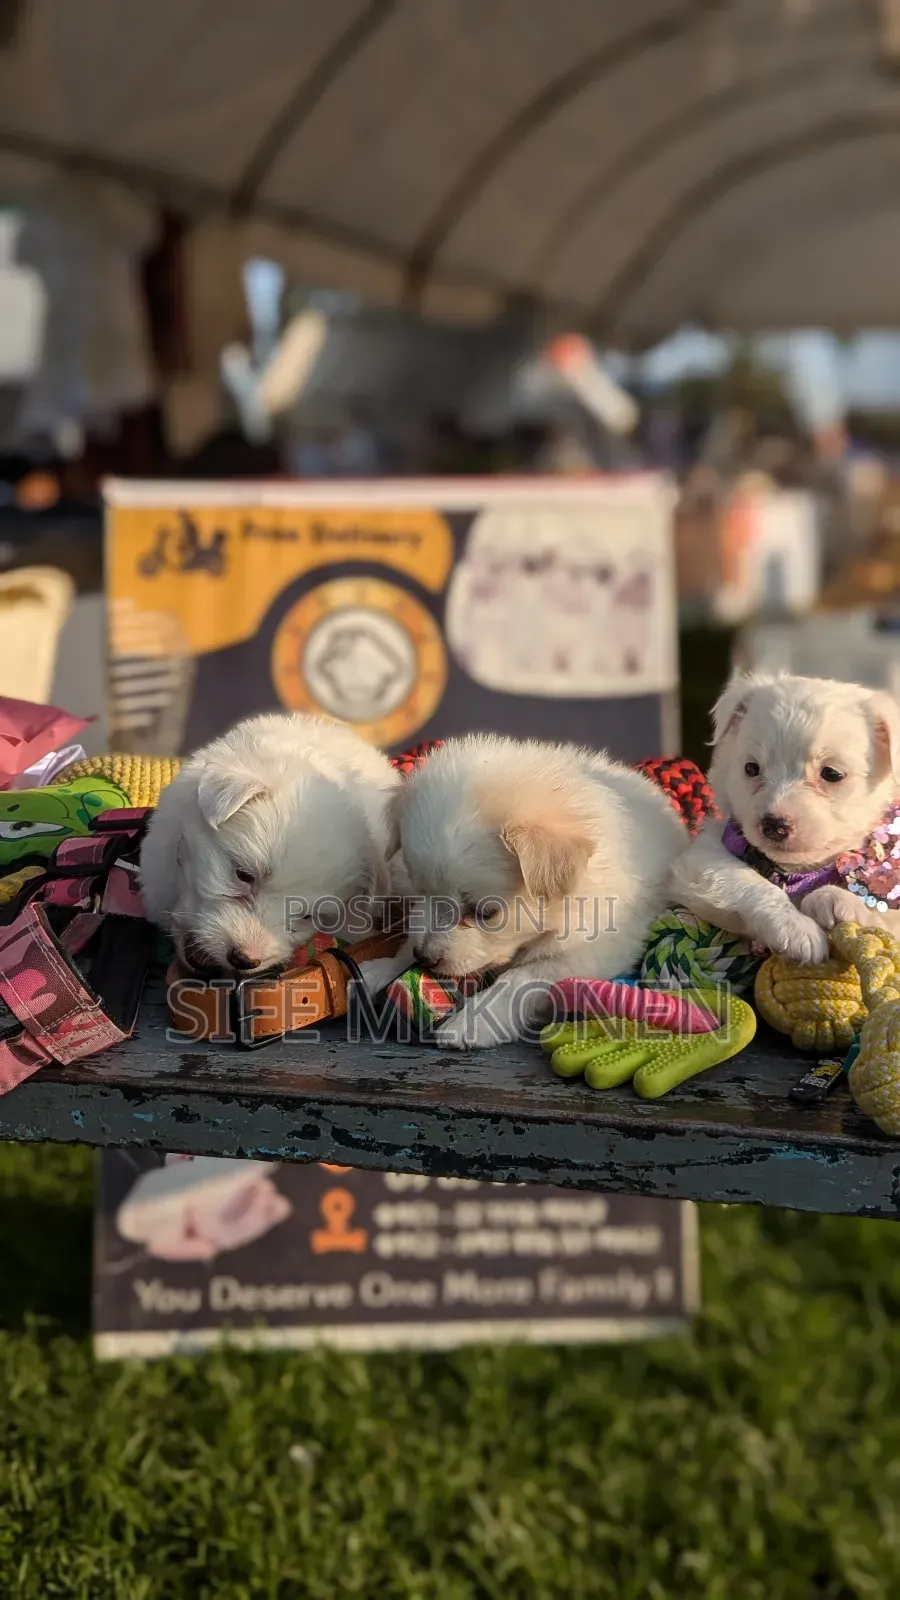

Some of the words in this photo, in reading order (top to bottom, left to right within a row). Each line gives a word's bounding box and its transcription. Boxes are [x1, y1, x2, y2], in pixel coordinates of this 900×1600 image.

[134, 1279, 200, 1313] You
[209, 1275, 353, 1312] Deserve
[359, 1270, 437, 1308] One
[443, 1269, 534, 1306] More
